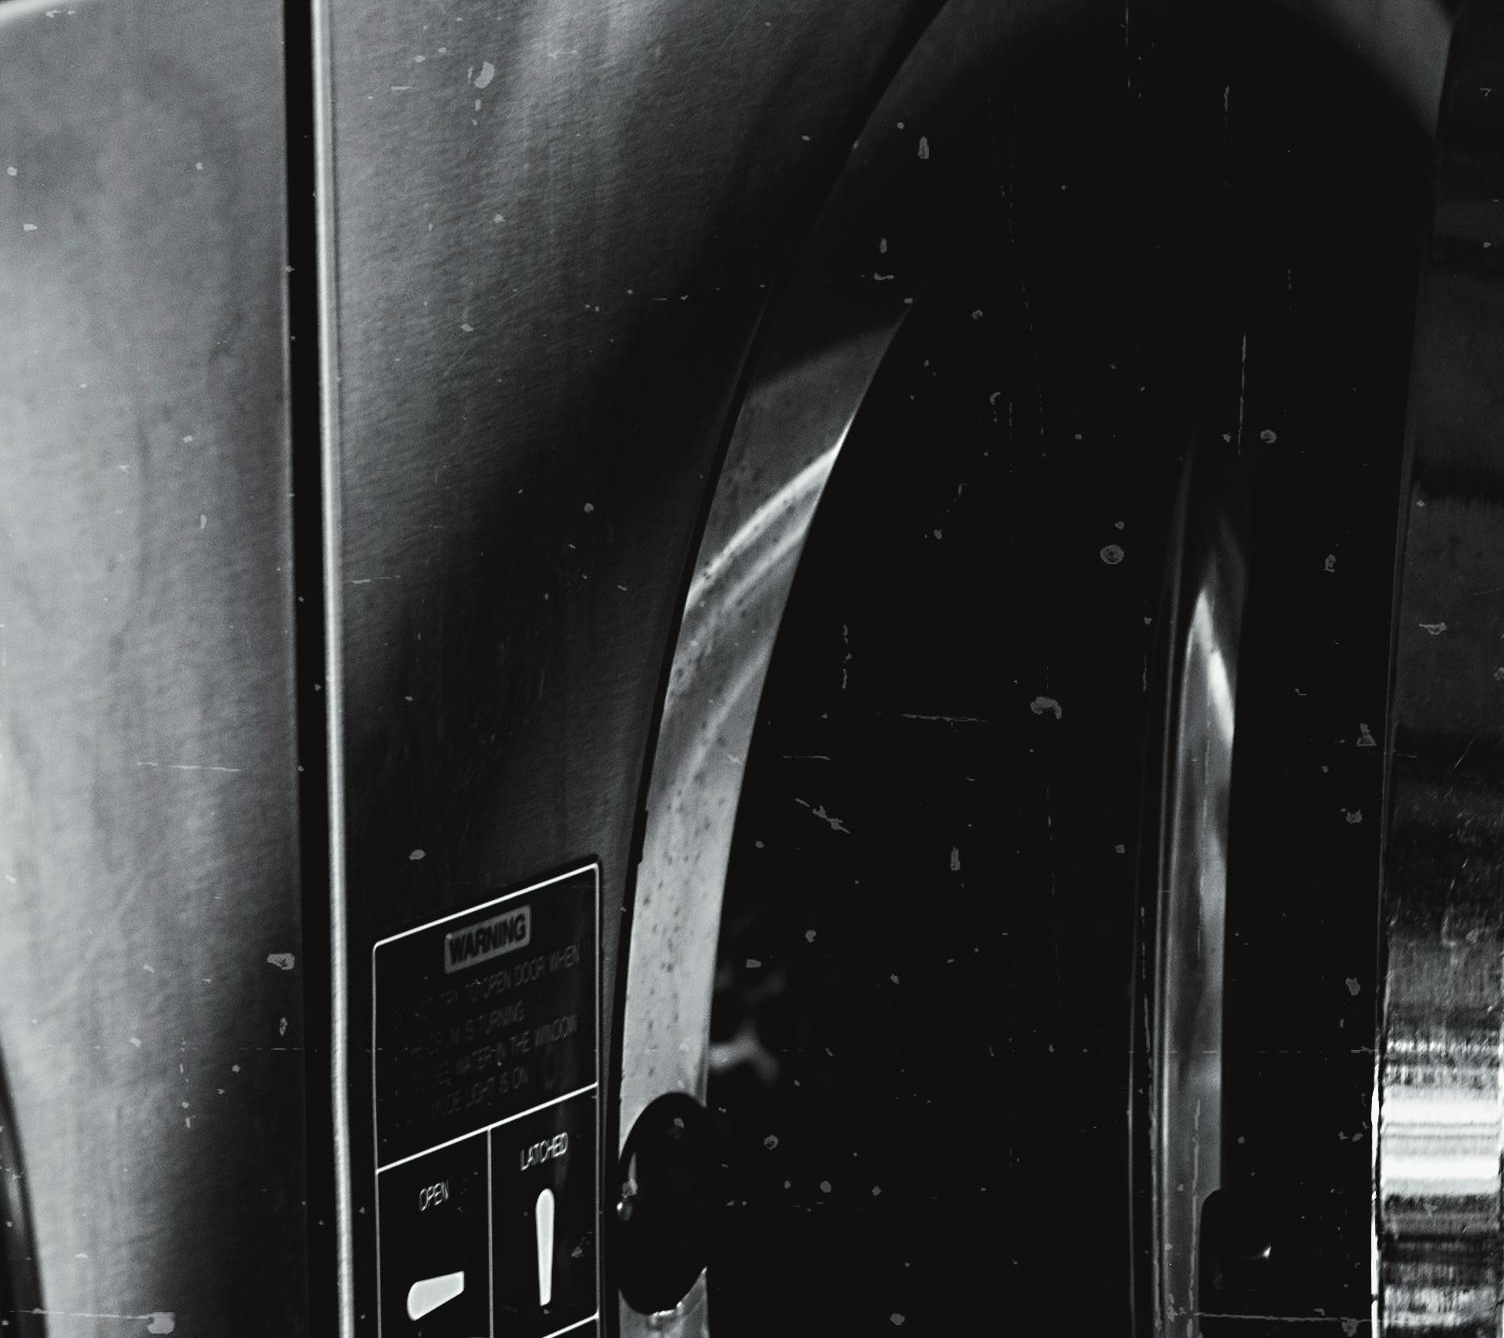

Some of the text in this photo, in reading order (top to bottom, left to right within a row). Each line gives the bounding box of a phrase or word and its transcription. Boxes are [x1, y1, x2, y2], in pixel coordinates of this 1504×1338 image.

[448, 914, 527, 965] WARNING
[520, 1131, 569, 1171] LATCHED
[418, 1181, 450, 1212] OPEN
